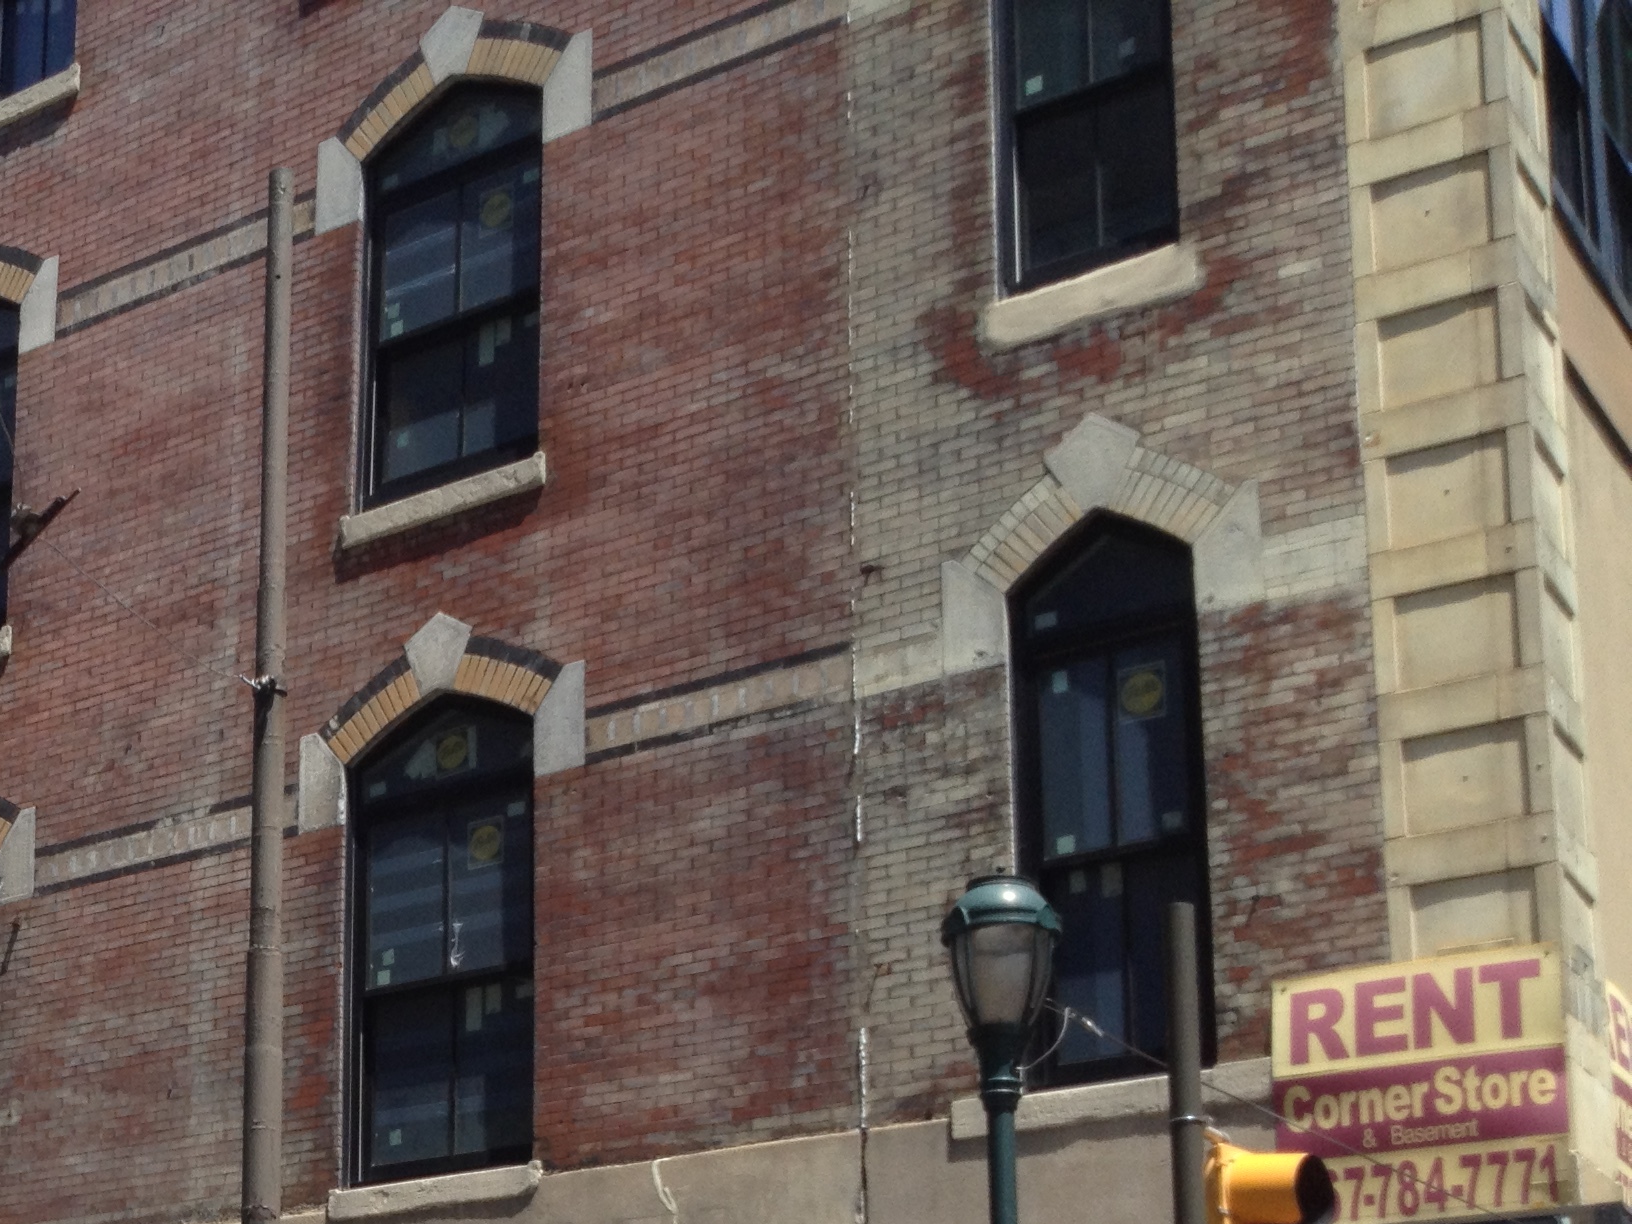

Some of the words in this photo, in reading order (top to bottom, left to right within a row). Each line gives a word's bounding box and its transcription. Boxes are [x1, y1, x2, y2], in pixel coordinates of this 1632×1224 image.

[1290, 958, 1541, 1066] RENT
[1283, 1079, 1431, 1133] Corner
[1432, 1065, 1558, 1116] Store
[1363, 1128, 1377, 1148] &
[1390, 1119, 1480, 1146] Basement
[1328, 1143, 1559, 1222] 7-784-7771
